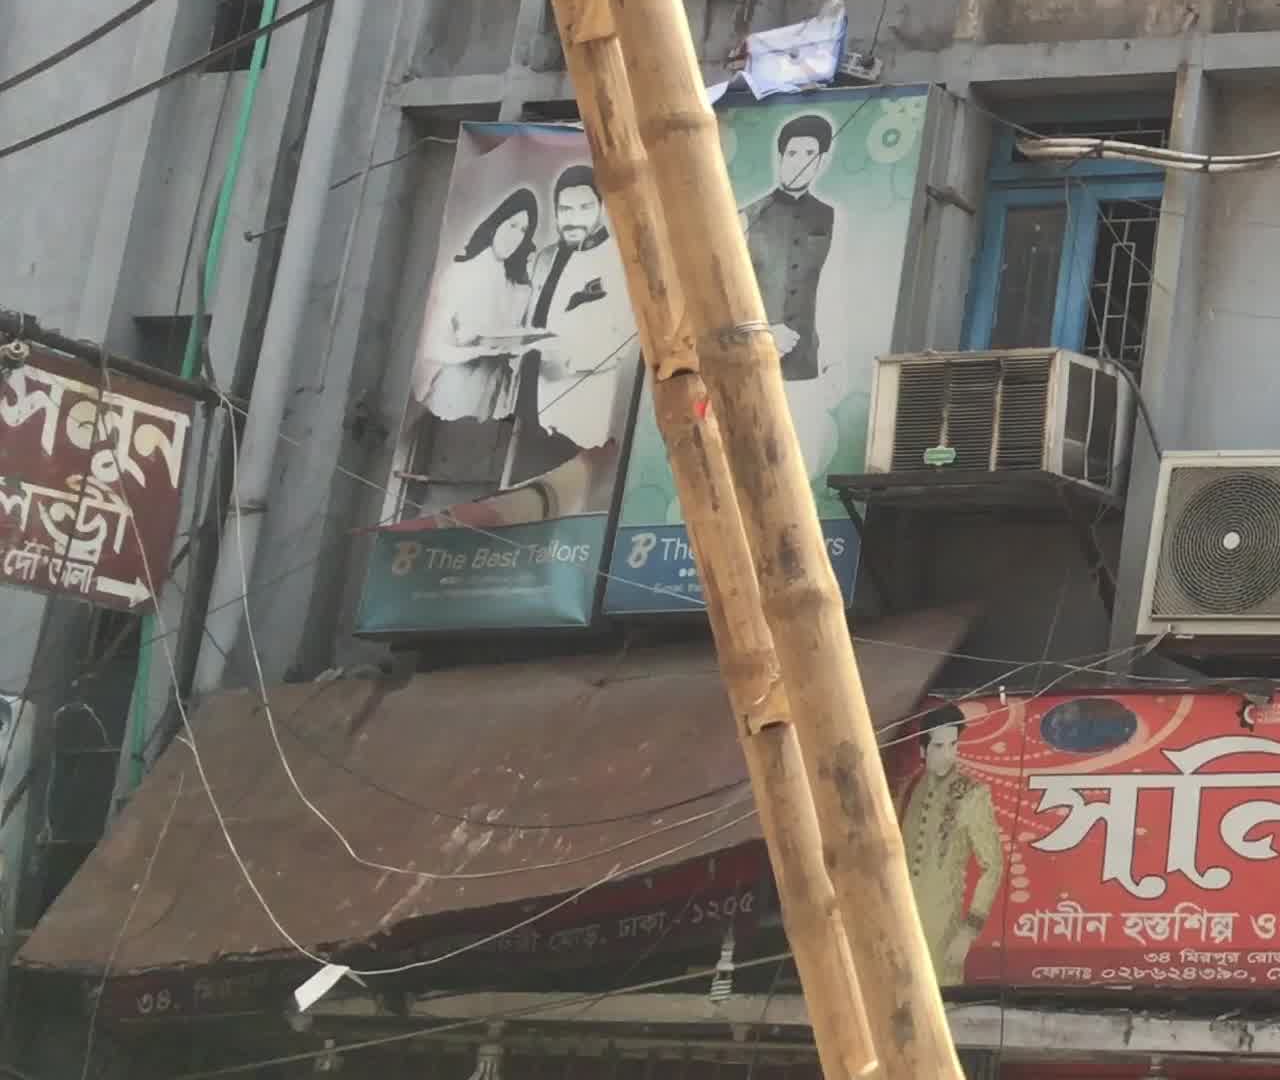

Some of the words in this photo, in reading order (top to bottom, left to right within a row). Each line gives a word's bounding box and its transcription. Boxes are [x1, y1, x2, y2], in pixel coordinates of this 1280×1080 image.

[425, 548, 465, 570] The
[472, 548, 521, 569] Best
[527, 540, 591, 563] Tailors
[1120, 901, 1241, 946] হস্তশিল্প
[1250, 912, 1277, 940] ও
[1143, 953, 1170, 964] ৩৪
[1180, 948, 1241, 965] মিরপুর
